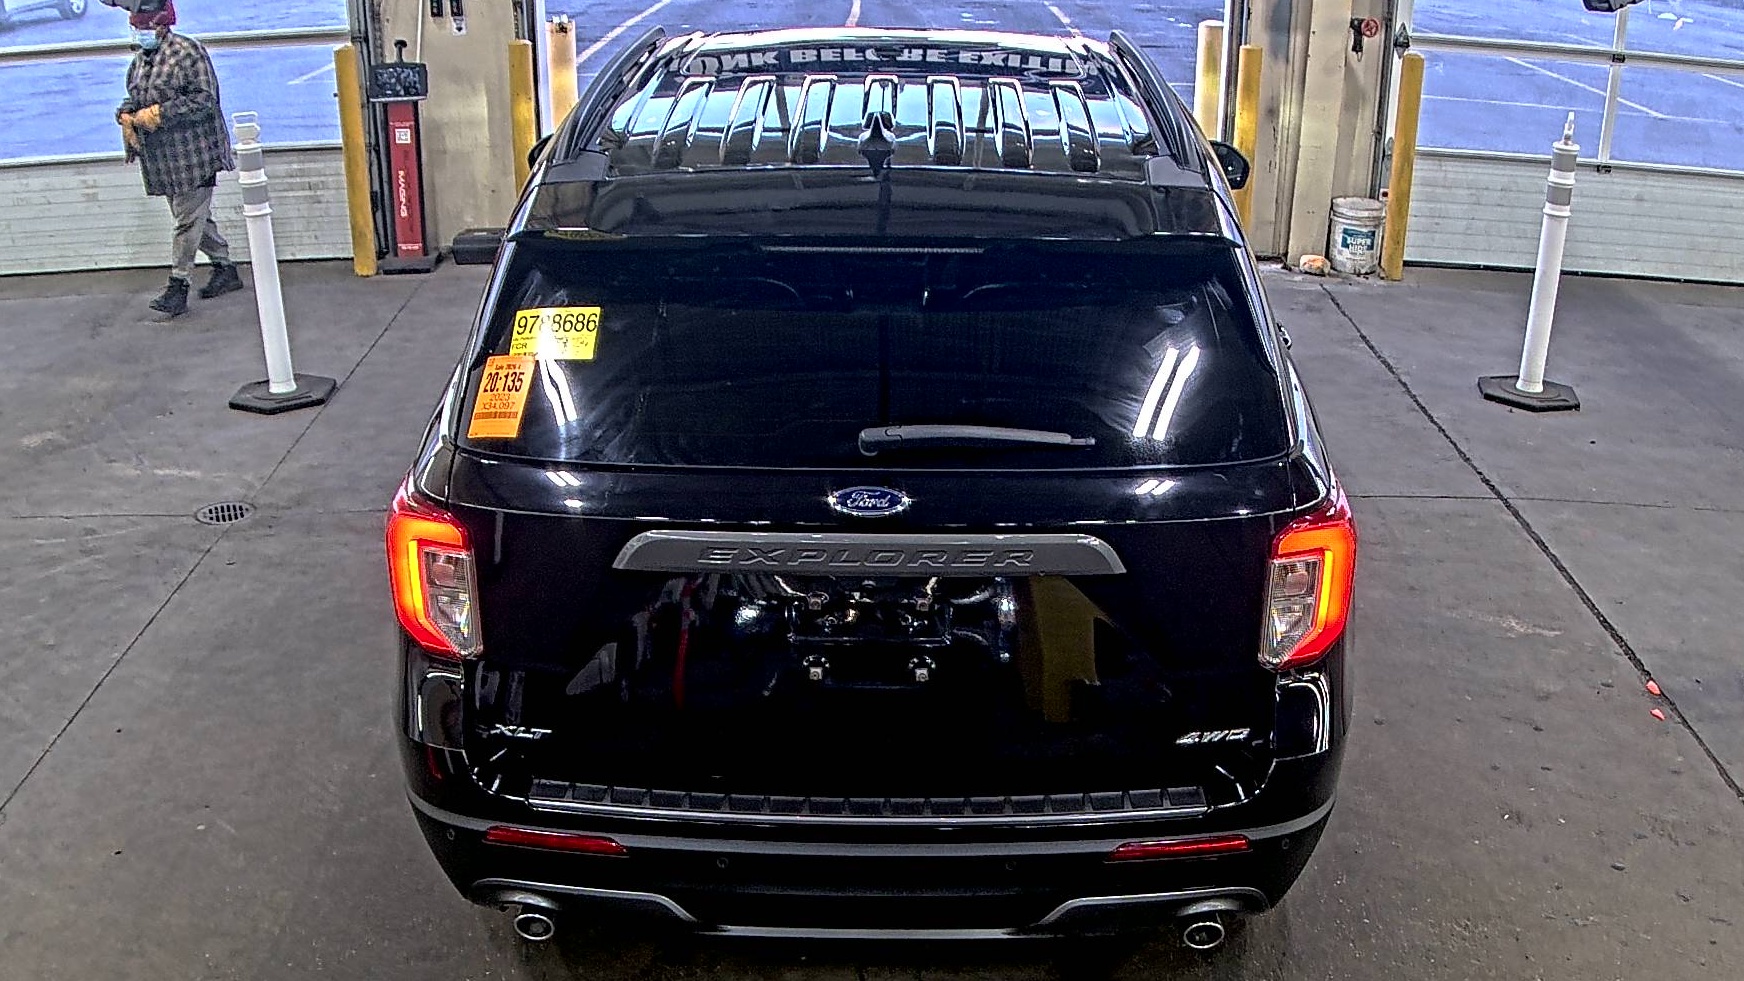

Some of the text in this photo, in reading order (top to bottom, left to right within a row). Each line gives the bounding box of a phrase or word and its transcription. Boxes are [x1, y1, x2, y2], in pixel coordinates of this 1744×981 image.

[483, 371, 525, 392] 20:135
[846, 491, 891, 507] Ford
[697, 547, 1034, 567] EXPLORER
[490, 723, 552, 739] XLT
[1175, 727, 1251, 744] 4WD
